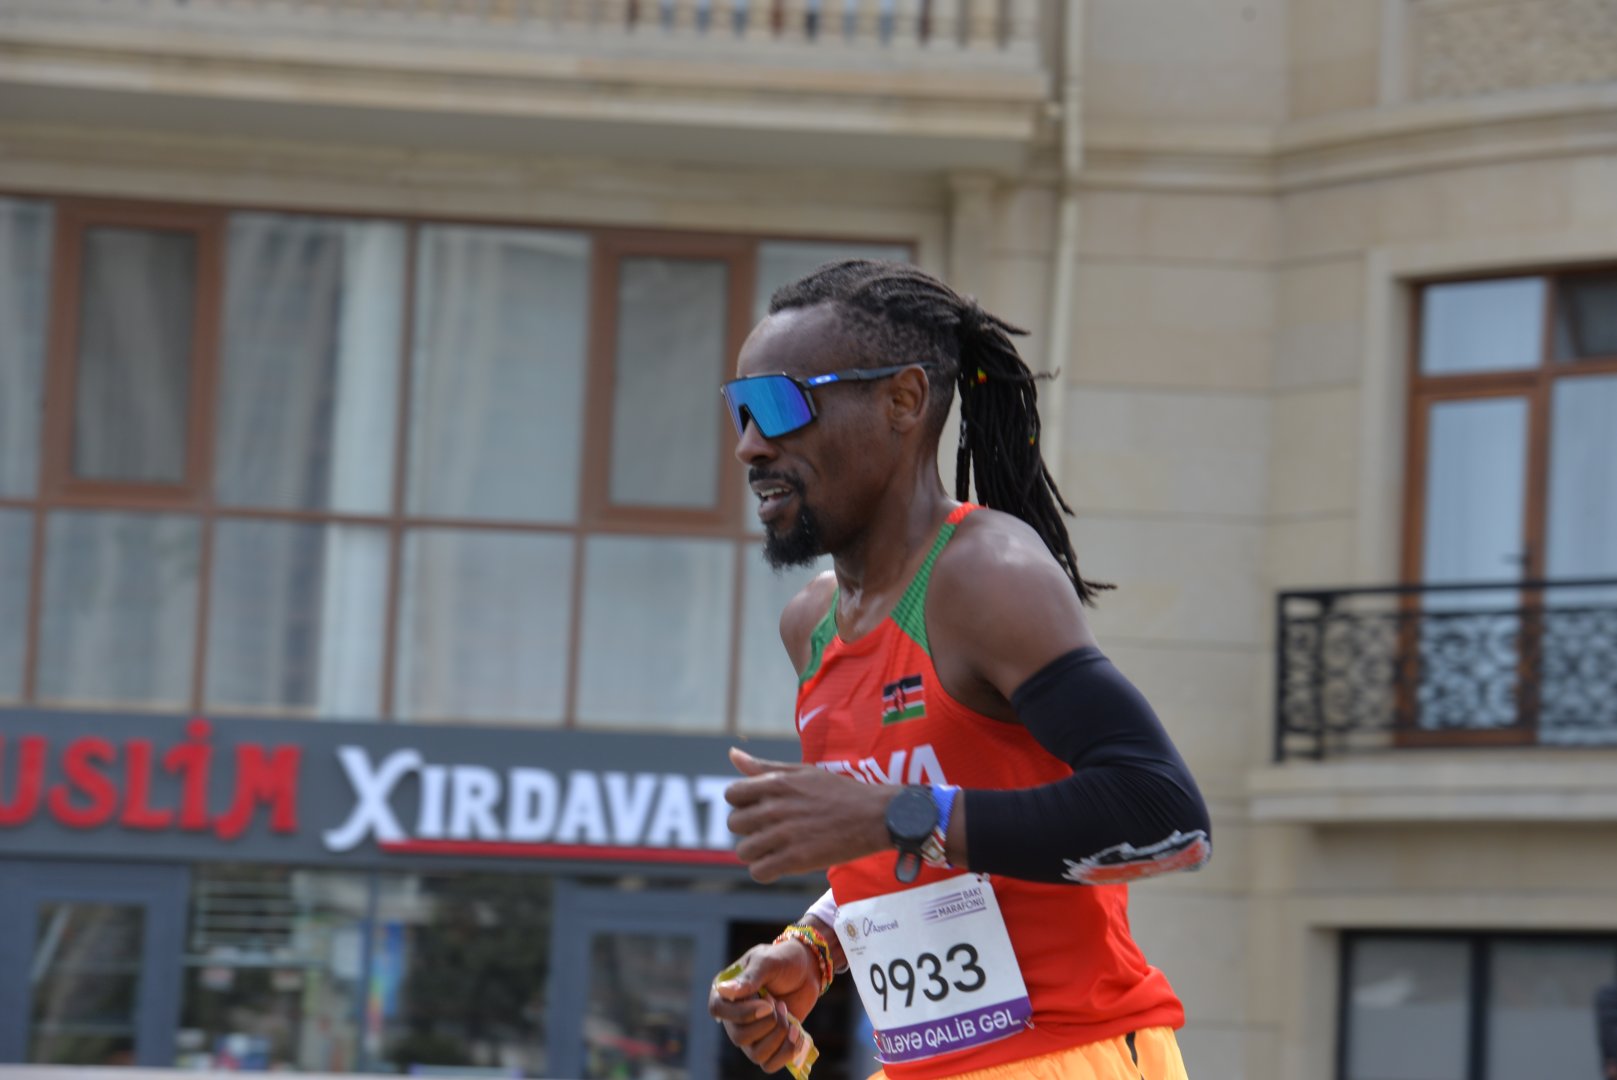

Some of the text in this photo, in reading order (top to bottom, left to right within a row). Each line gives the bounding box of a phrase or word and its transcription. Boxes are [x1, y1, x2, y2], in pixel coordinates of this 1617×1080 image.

[322, 745, 739, 851] XIRDAVAT
[938, 897, 985, 917] MARAFONU
[870, 943, 986, 1012] 9933
[924, 1017, 976, 1048] QALİB
[978, 1008, 1021, 1033] GƏL
